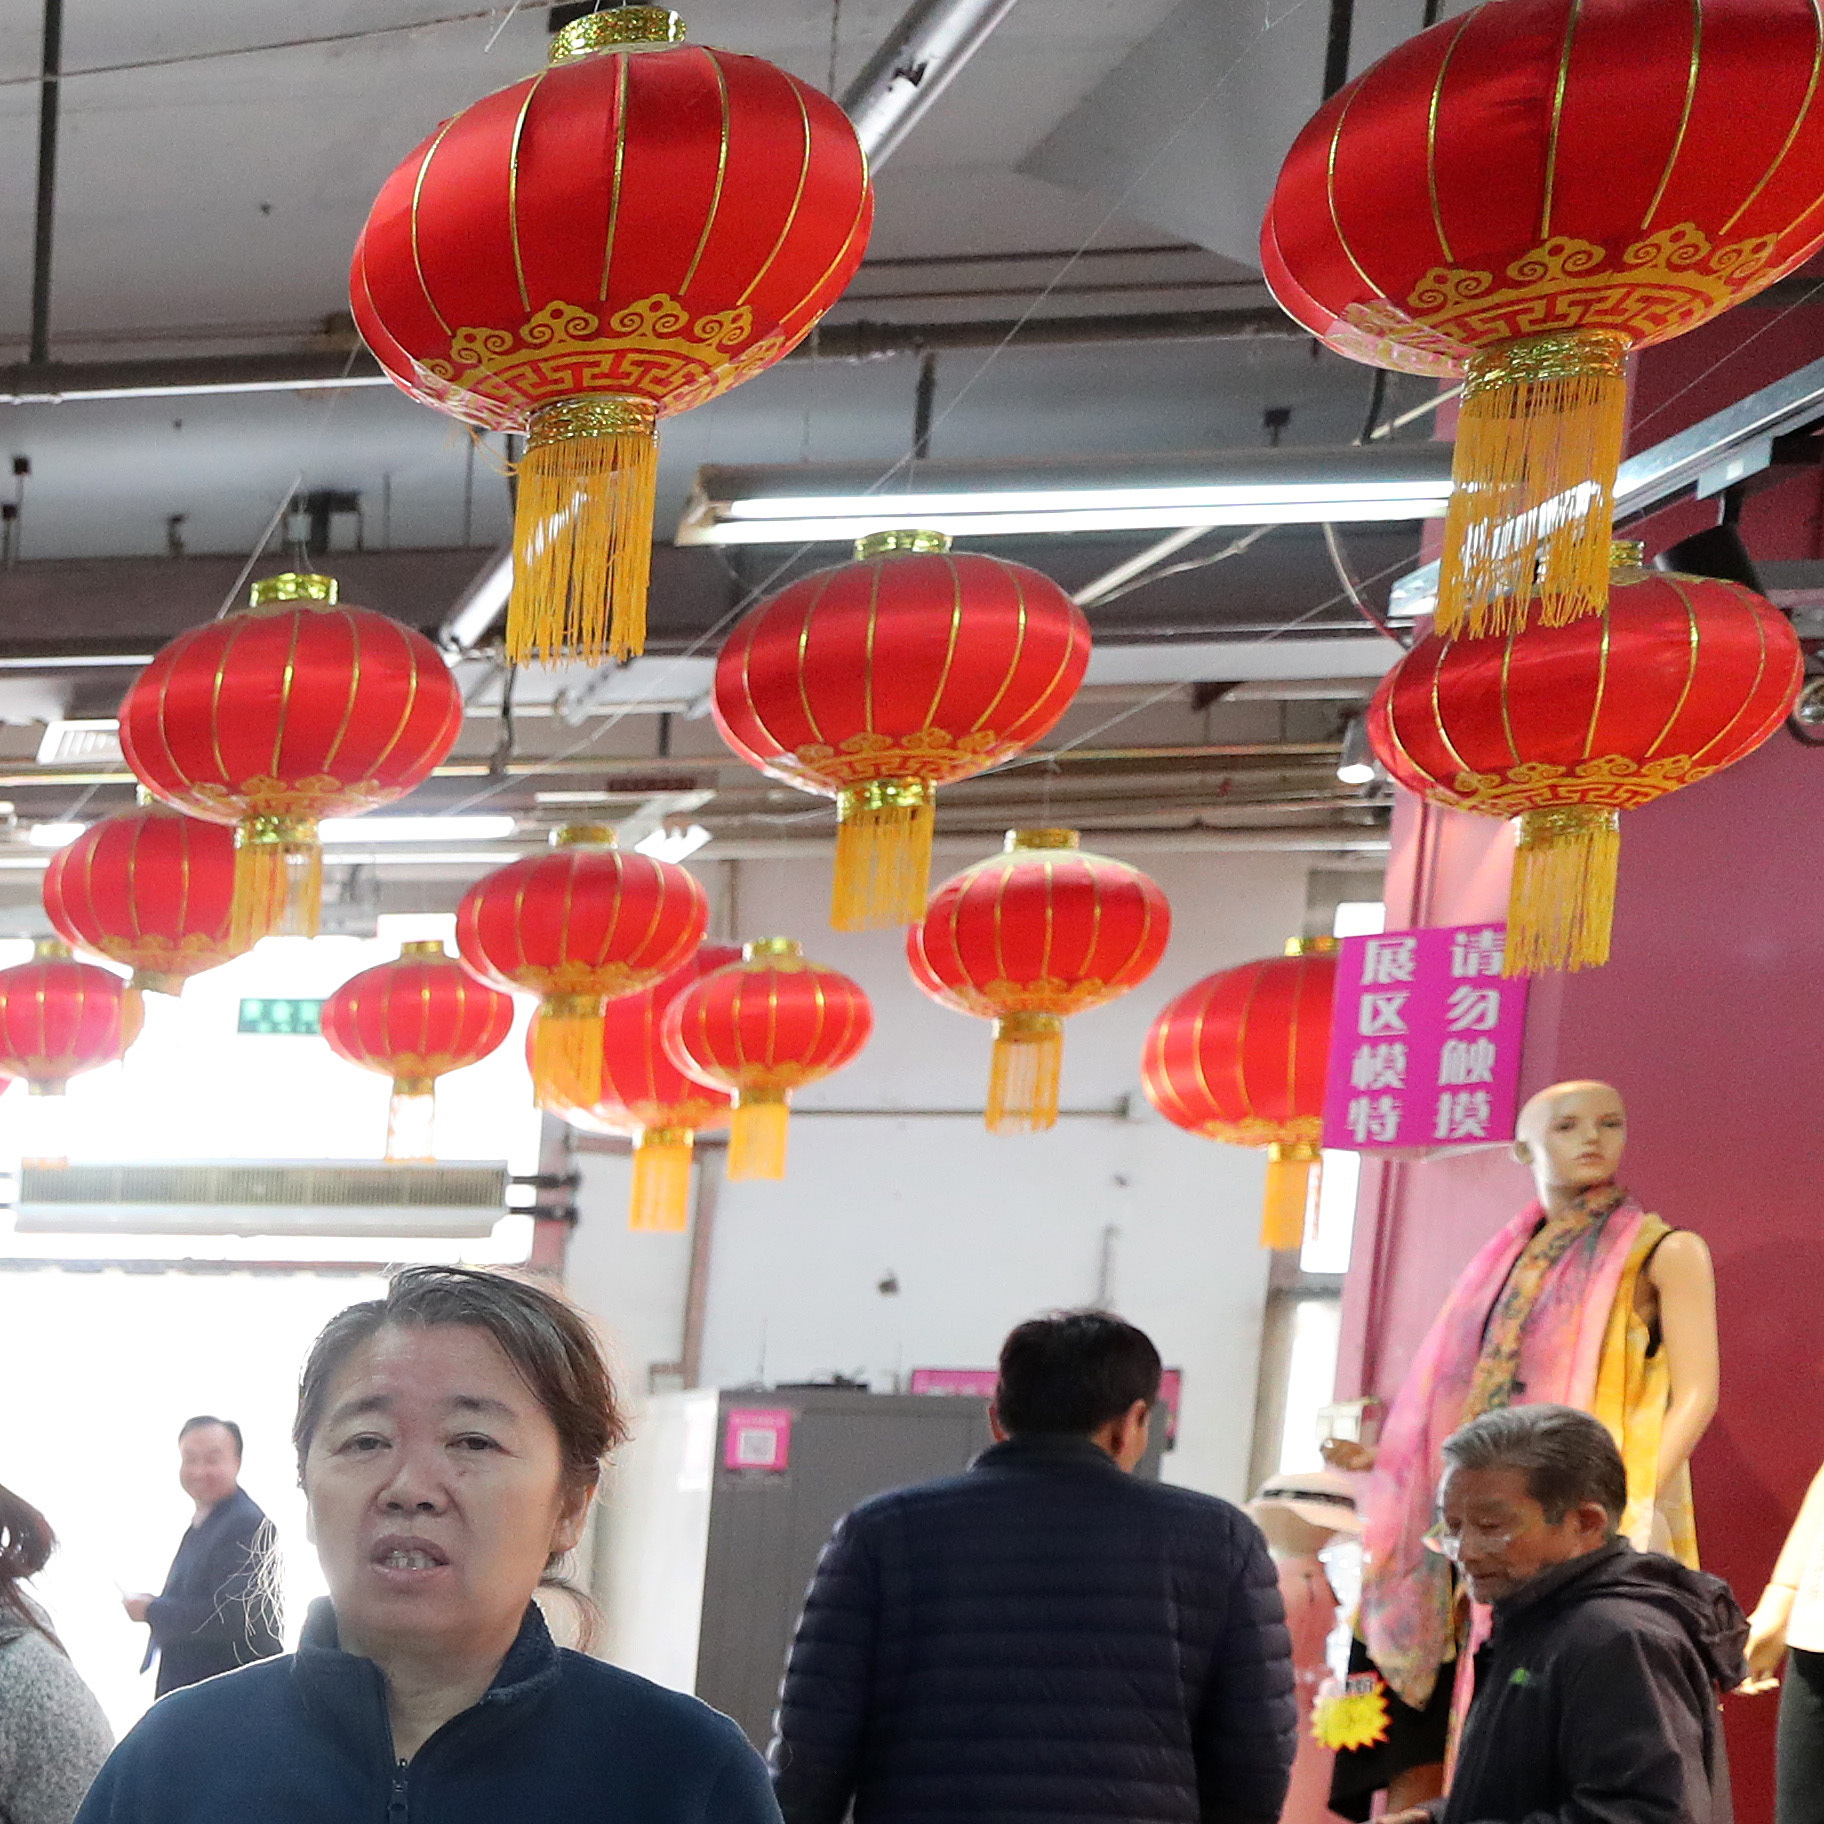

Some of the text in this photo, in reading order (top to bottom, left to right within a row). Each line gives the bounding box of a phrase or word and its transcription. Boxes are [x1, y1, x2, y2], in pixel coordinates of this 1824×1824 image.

[1345, 936, 1419, 1144] 展区模特
[1433, 929, 1507, 1139] 请勿触摸
